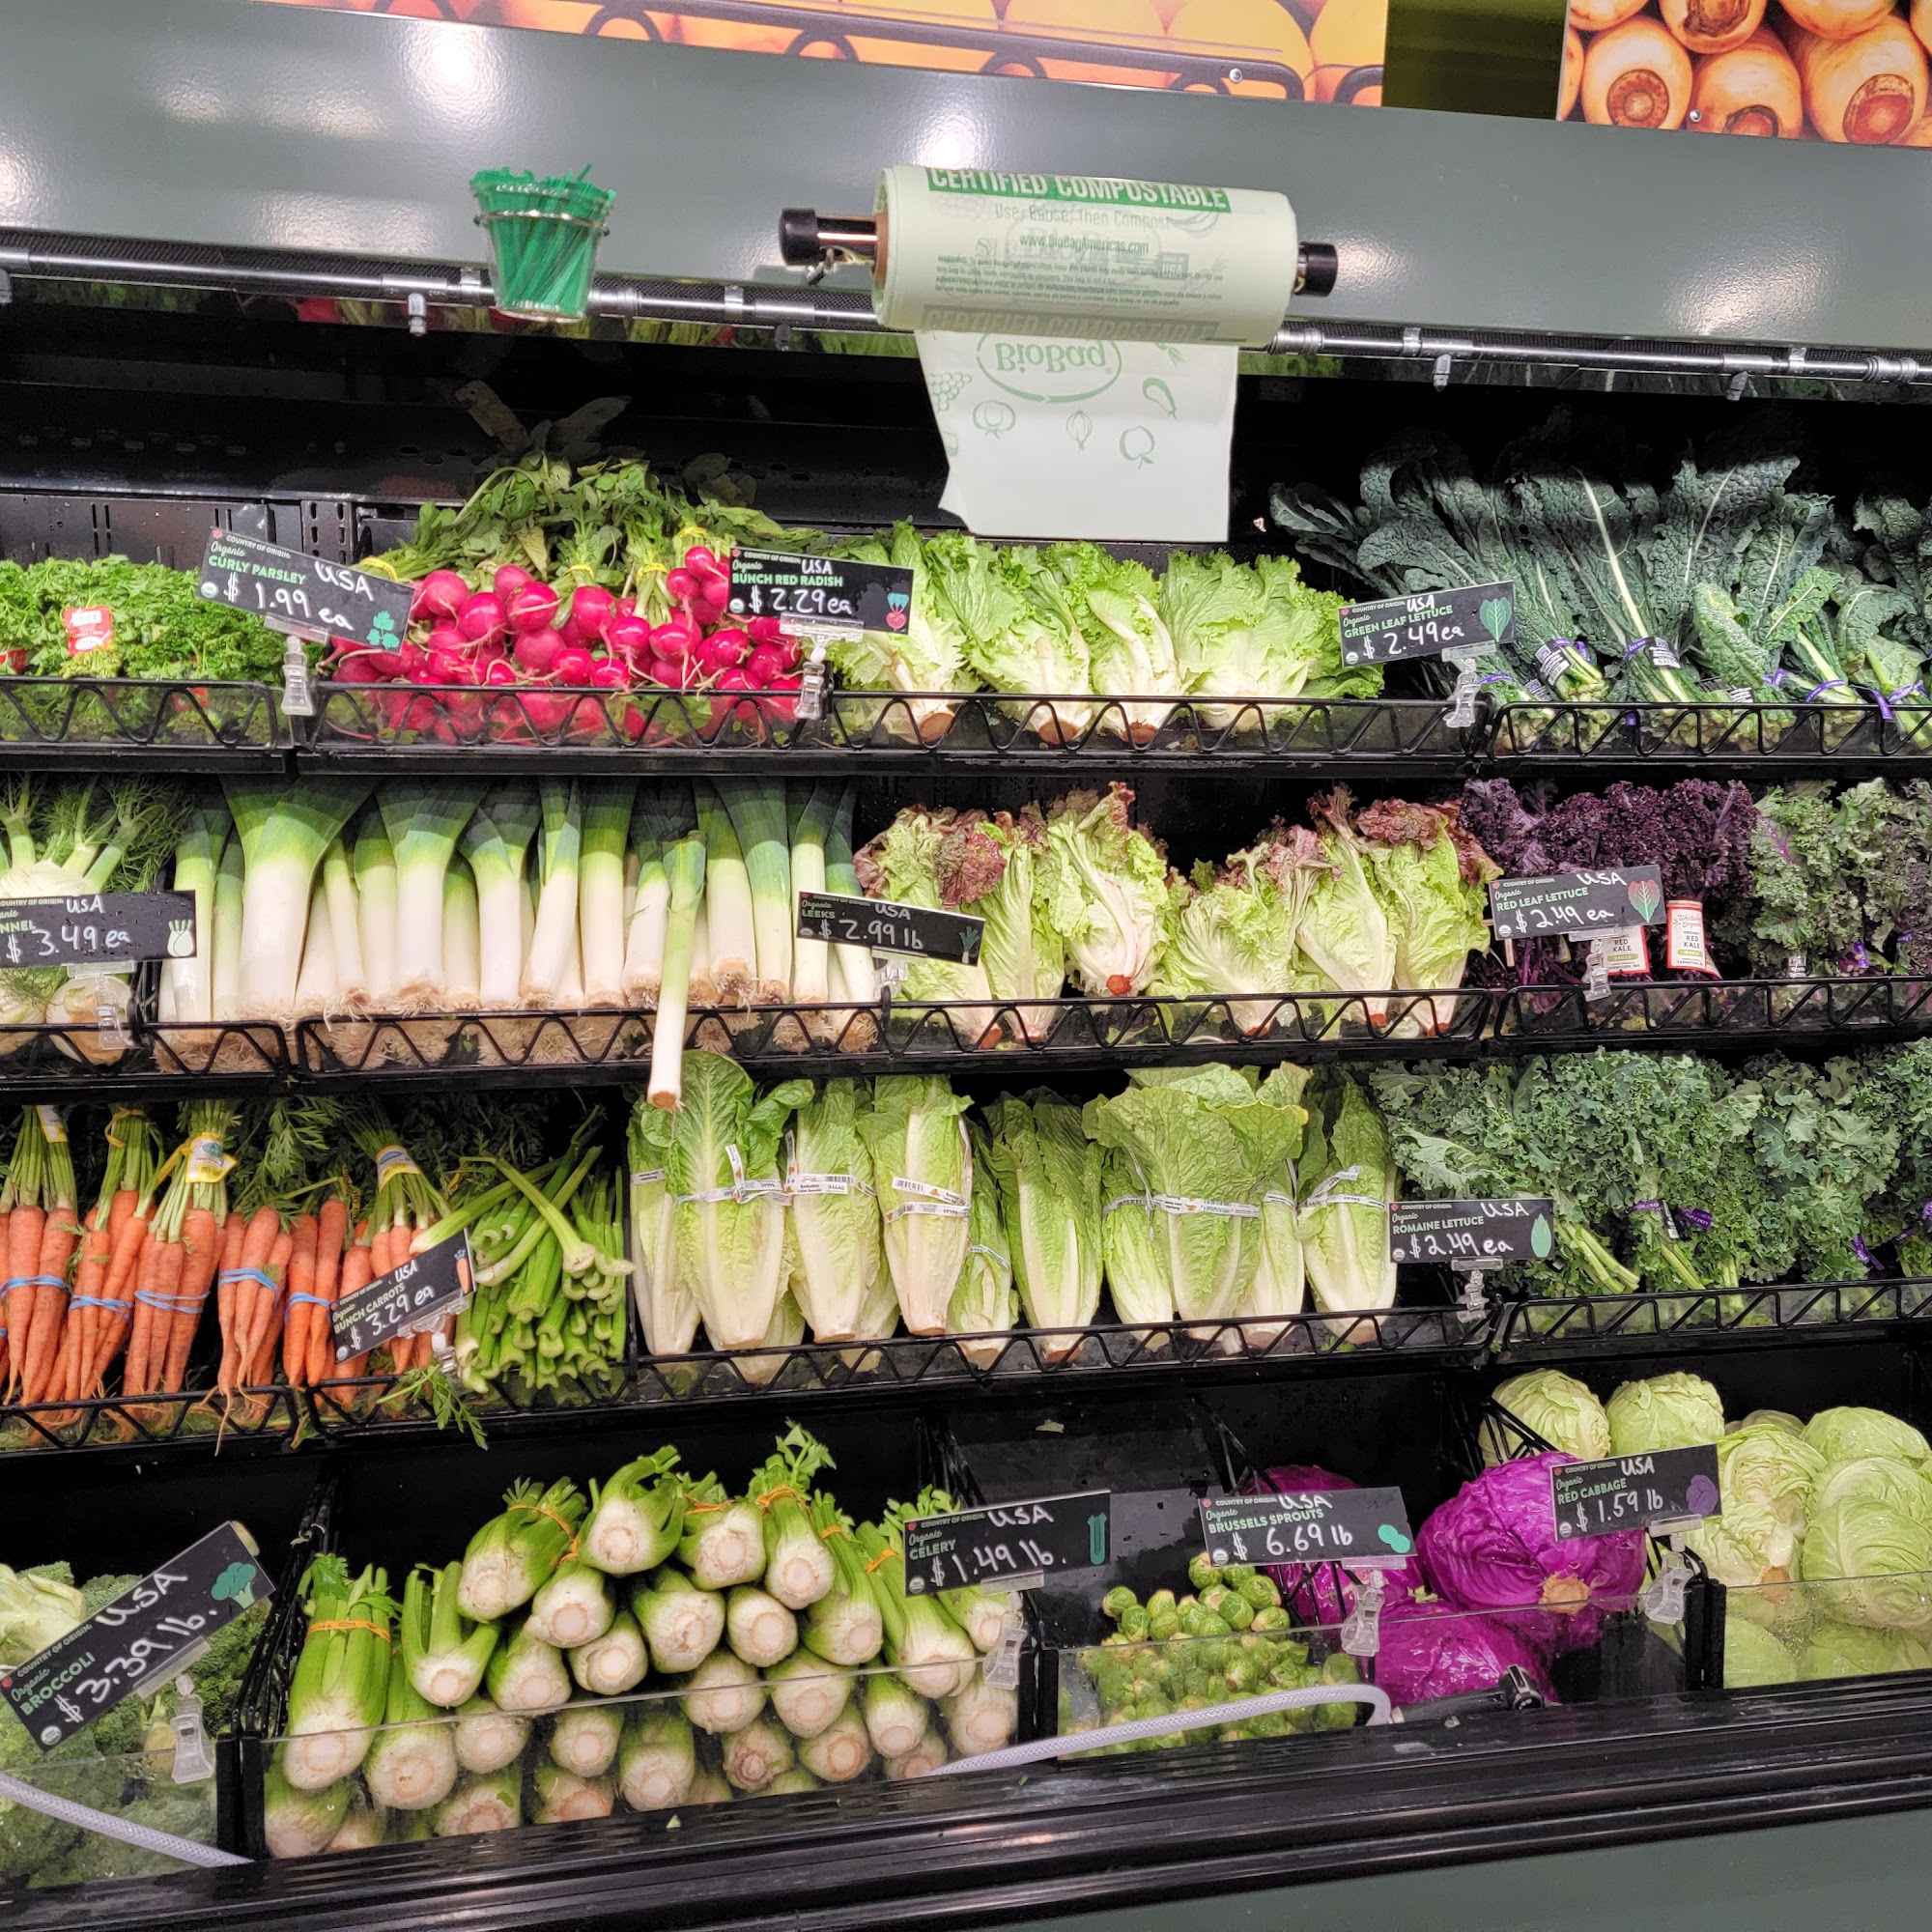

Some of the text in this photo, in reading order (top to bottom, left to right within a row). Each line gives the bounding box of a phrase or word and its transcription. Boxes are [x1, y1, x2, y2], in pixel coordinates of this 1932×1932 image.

[931, 169, 1226, 208] CERTIFIED COMPOSTABLE
[1078, 208, 1109, 225] Then
[1114, 210, 1169, 231] Compost
[1019, 233, 1149, 253] www.BioBagAmericas.com
[211, 541, 246, 557] Organic
[209, 555, 306, 585] CURLY PARSLEY
[226, 535, 255, 550] COUNTRY
[315, 561, 375, 602] USA
[732, 559, 763, 573] Organic
[801, 559, 833, 575] USA
[732, 573, 843, 587] BUNCH RED RADISH
[223, 572, 239, 603] $
[255, 582, 311, 618] 1.99
[318, 608, 355, 631] ea
[749, 584, 763, 614] $
[770, 588, 826, 613] 2.29
[828, 599, 853, 614] ea
[1352, 605, 1376, 613] COUNTRY
[1406, 594, 1435, 612] USA
[1343, 613, 1371, 628] Organic
[1345, 605, 1453, 639] GREEN LEAF LETTUCE
[1363, 635, 1375, 659] $
[1383, 621, 1438, 655] 2.49
[1441, 626, 1465, 640] ea
[1577, 871, 1628, 886] USA
[66, 895, 105, 914] USA
[802, 899, 832, 912] Organic
[1494, 889, 1521, 900] Organic
[1496, 887, 1589, 912] RED LEAF LETTUCE
[0, 909, 19, 919] anic
[802, 909, 836, 919] LEEKS
[875, 903, 911, 921] USA
[1516, 909, 1527, 933] $
[1530, 905, 1585, 927] 2.49
[1586, 908, 1614, 921] ea
[0, 919, 36, 934] NNEL
[818, 919, 923, 950] $ 2.99 lb
[6, 925, 132, 963] $ 3.49 ea
[1392, 1212, 1419, 1225] Organic
[1481, 1202, 1530, 1218] USA
[1393, 1216, 1485, 1235] ROMAINE LETTUCE
[1409, 1234, 1422, 1259] $
[1425, 1233, 1481, 1256] 2.49
[1483, 1239, 1514, 1254] ea
[394, 1259, 419, 1282] USA
[333, 1282, 406, 1334] BUNCH CARROTS
[333, 1304, 355, 1322] Organic
[351, 1285, 435, 1350] $ 3.29 ea
[1621, 1456, 1655, 1476] USA
[1555, 1476, 1584, 1492] Organic
[1557, 1478, 1628, 1505] RED CABBAGE
[1215, 1498, 1244, 1507] COUNTRY
[1278, 1493, 1333, 1510] USA
[1576, 1501, 1588, 1533] $
[1598, 1491, 1638, 1523] 1.59
[1646, 1489, 1663, 1511] lb
[921, 1518, 951, 1528] COUNTRY
[988, 1504, 1055, 1527] USA
[1206, 1507, 1238, 1521] Organic
[1208, 1508, 1324, 1534] BRUSSELS SPROUTS
[908, 1530, 943, 1546] Organic
[910, 1538, 956, 1560] CELERY
[1233, 1532, 1248, 1561] $
[1266, 1522, 1324, 1555] 6.69
[1330, 1524, 1353, 1546] lb
[930, 1555, 946, 1587] $
[952, 1544, 1017, 1583] 1.49
[1019, 1539, 1066, 1568] lb.
[16, 1653, 52, 1678] COUNTRY
[52, 1642, 63, 1655] OF
[95, 1572, 188, 1627] USA
[54, 1608, 217, 1722] $ 3.39 lb.
[11, 1667, 50, 1702] Organic
[19, 1652, 96, 1716] BROCCOLI
